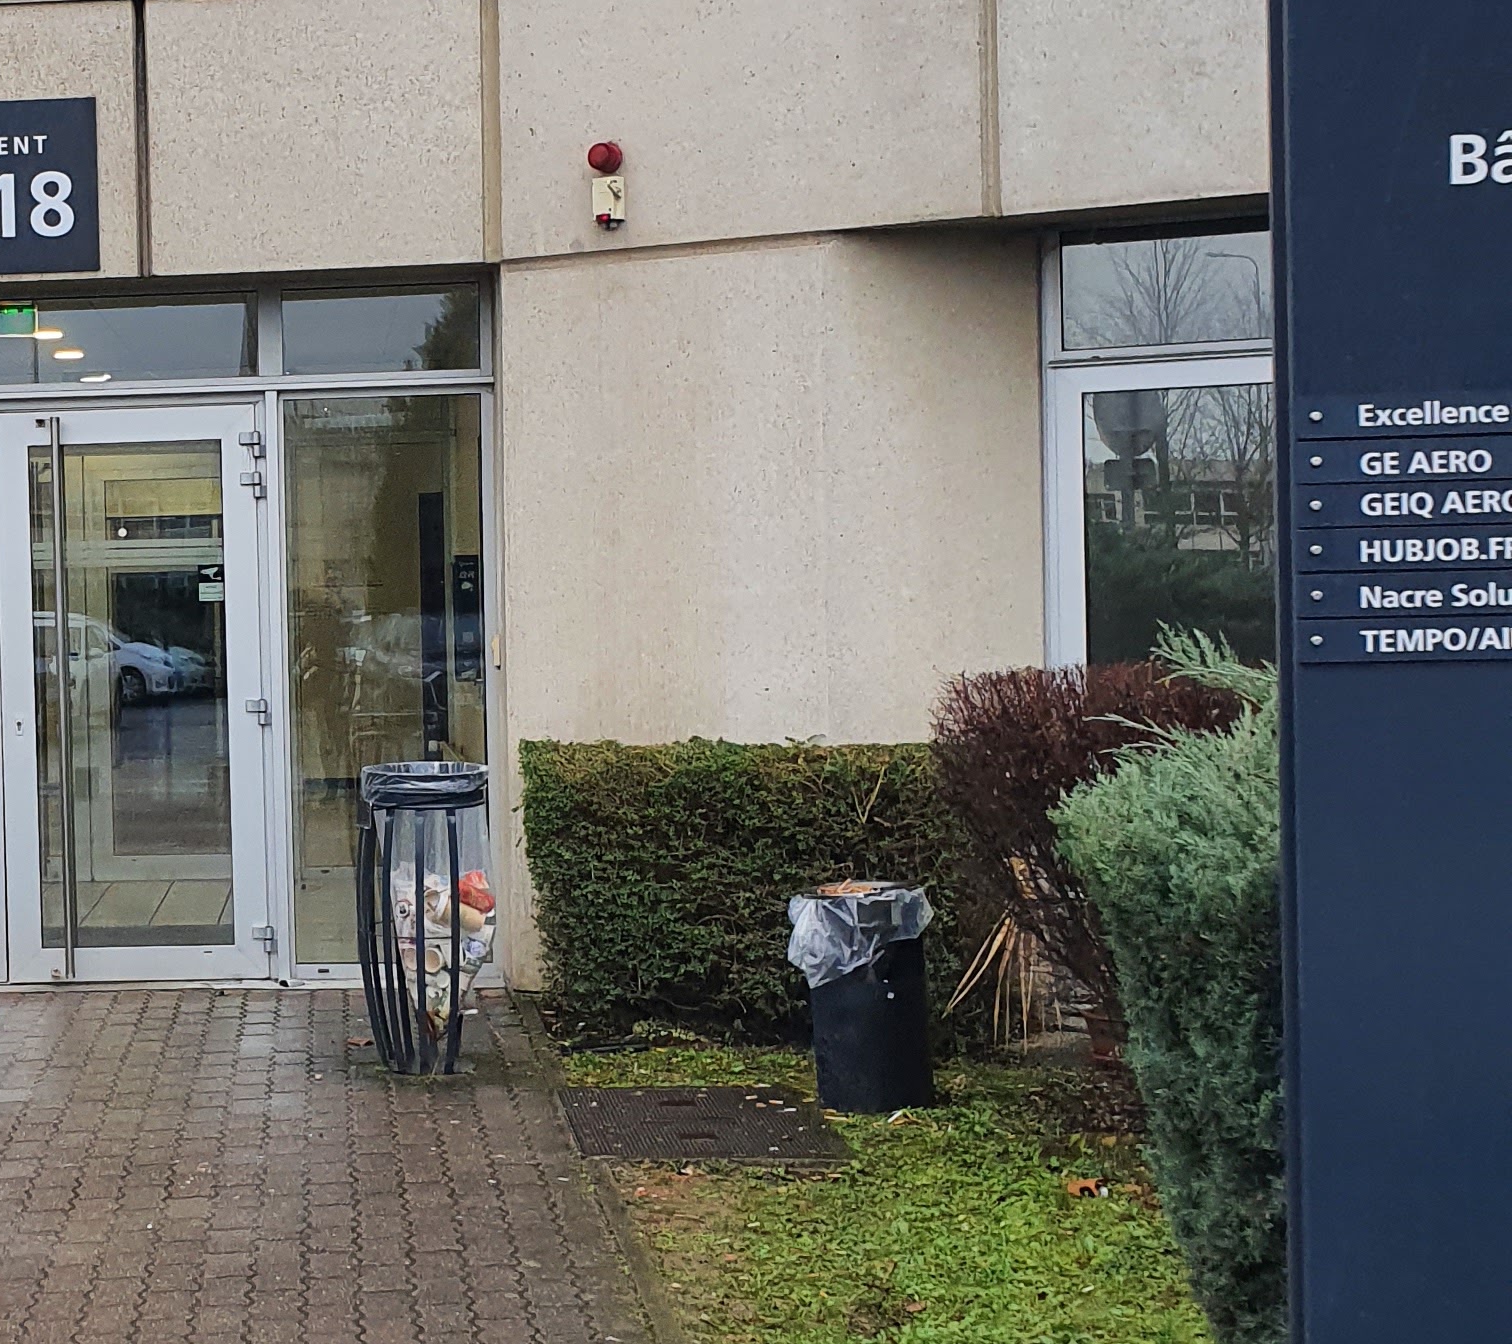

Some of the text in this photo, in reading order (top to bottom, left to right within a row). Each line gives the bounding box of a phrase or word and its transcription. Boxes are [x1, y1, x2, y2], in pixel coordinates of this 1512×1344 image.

[1357, 400, 1510, 427] Excellence
[1359, 449, 1493, 475] GE AERO
[1360, 491, 1435, 519] GEIQ
[1359, 585, 1444, 609] Nacre
